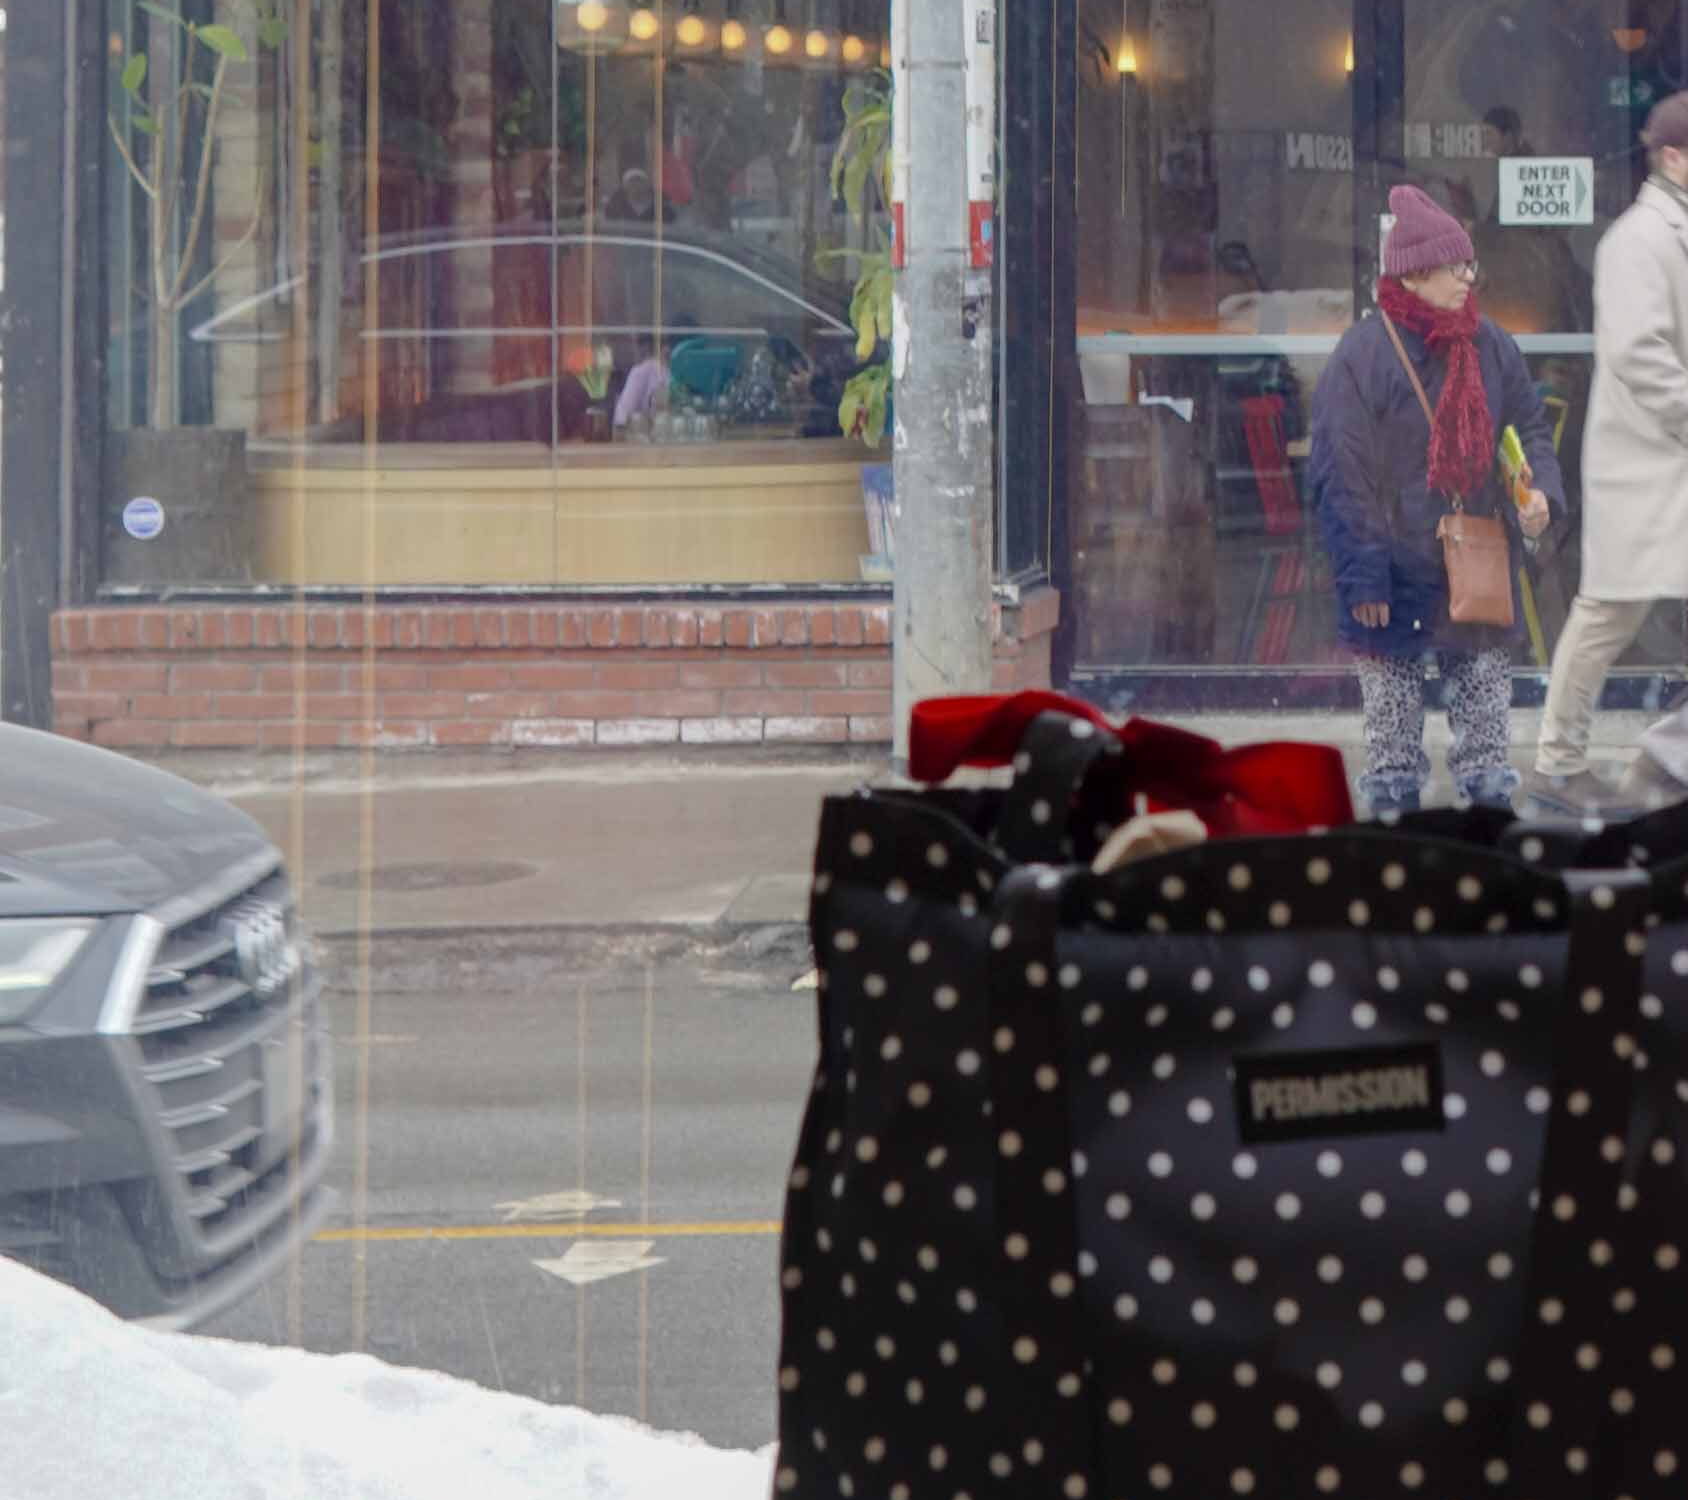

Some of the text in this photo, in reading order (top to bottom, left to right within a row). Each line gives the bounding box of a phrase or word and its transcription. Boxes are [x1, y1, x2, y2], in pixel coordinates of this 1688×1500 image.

[1518, 165, 1570, 181] ENTER
[1522, 183, 1567, 198] NEXT
[1516, 200, 1570, 217] DOOR
[1248, 1065, 1430, 1122] PERMISSION
